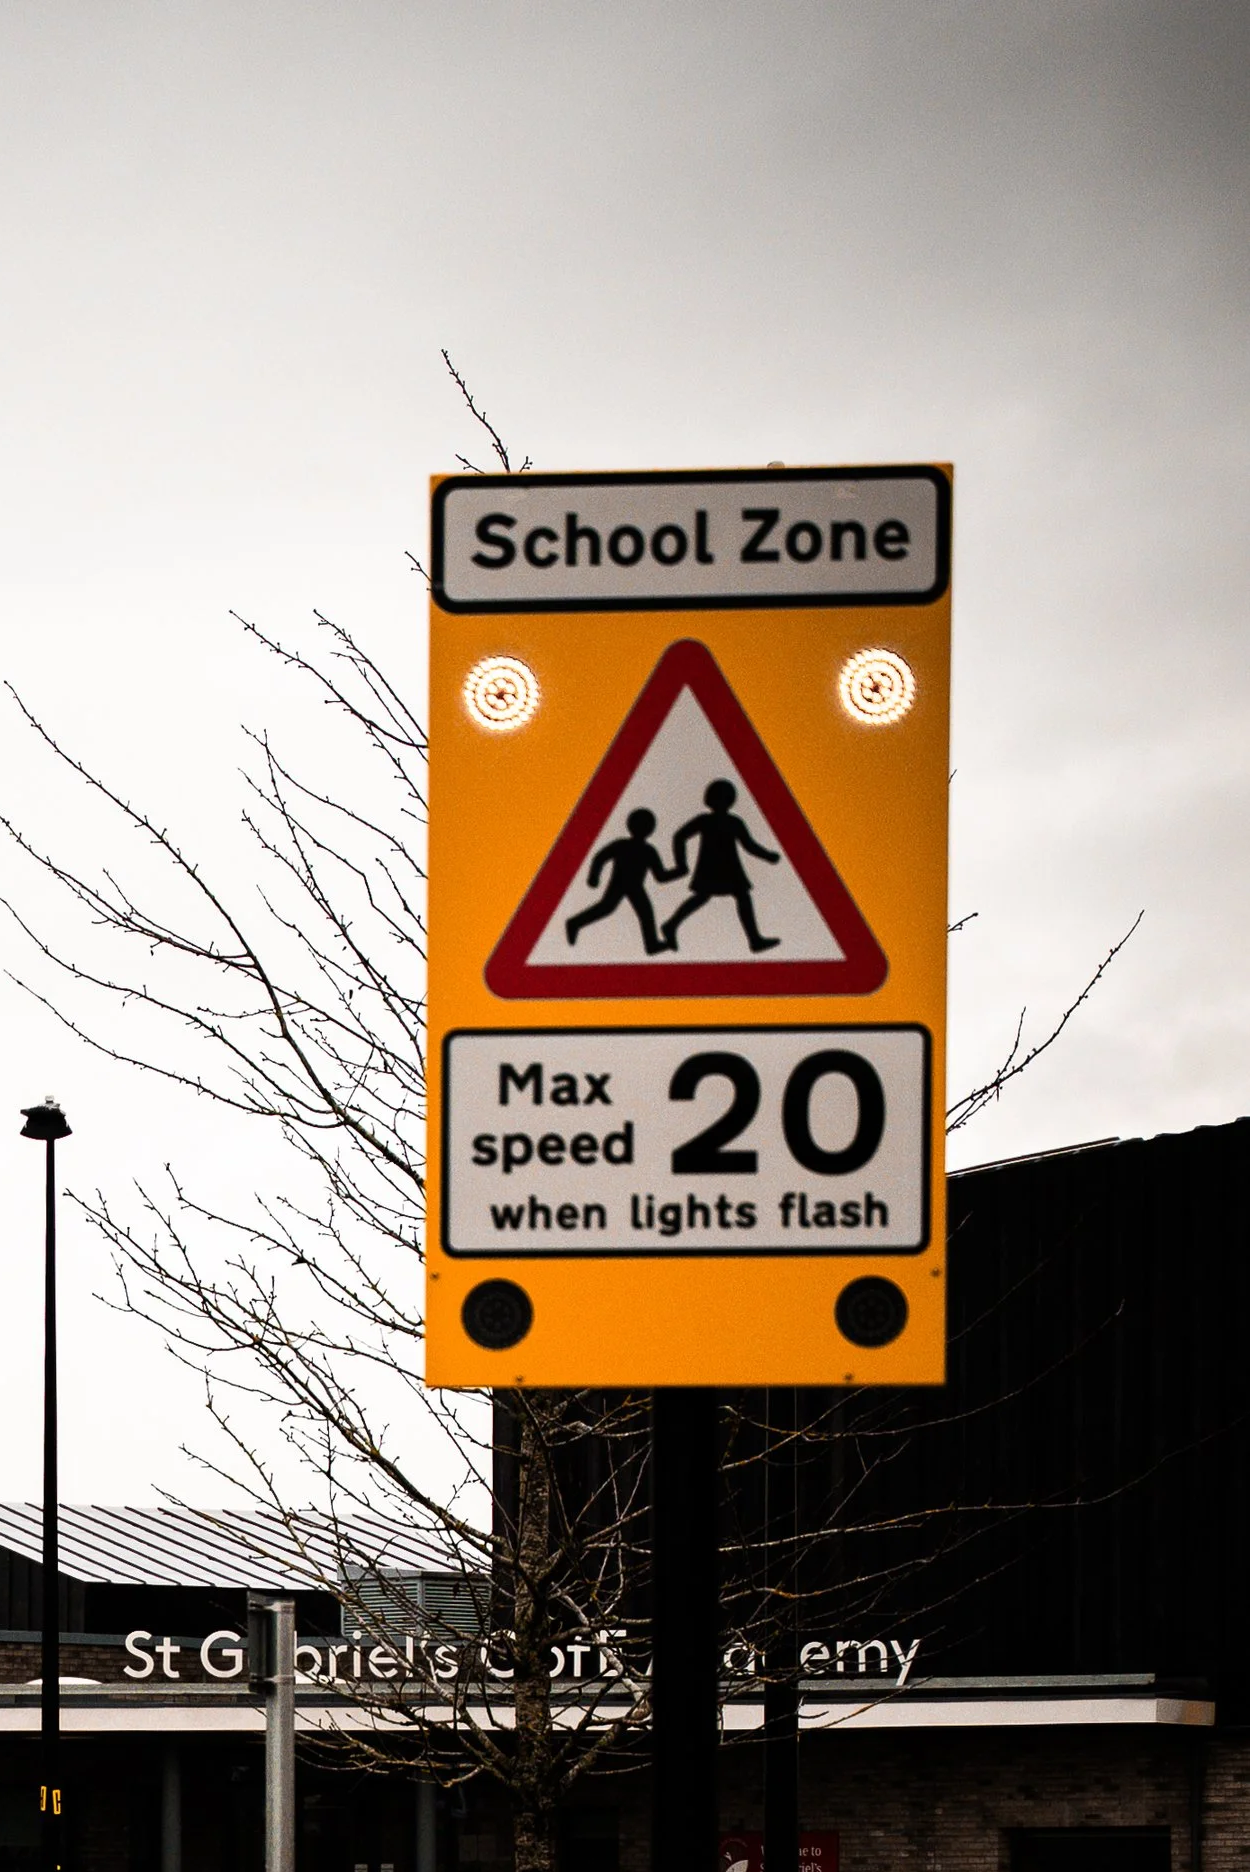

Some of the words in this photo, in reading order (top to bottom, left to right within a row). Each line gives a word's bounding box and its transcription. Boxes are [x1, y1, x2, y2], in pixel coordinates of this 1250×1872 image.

[472, 510, 714, 569] School
[740, 508, 911, 563] Zone
[499, 1063, 612, 1106] Max
[669, 1049, 886, 1176] 20
[472, 1121, 635, 1174] speed
[490, 1195, 607, 1231] when
[631, 1194, 757, 1237] lights
[779, 1192, 889, 1229] flash
[123, 1630, 181, 1679] St
[201, 1630, 459, 1679] Gbriel's
